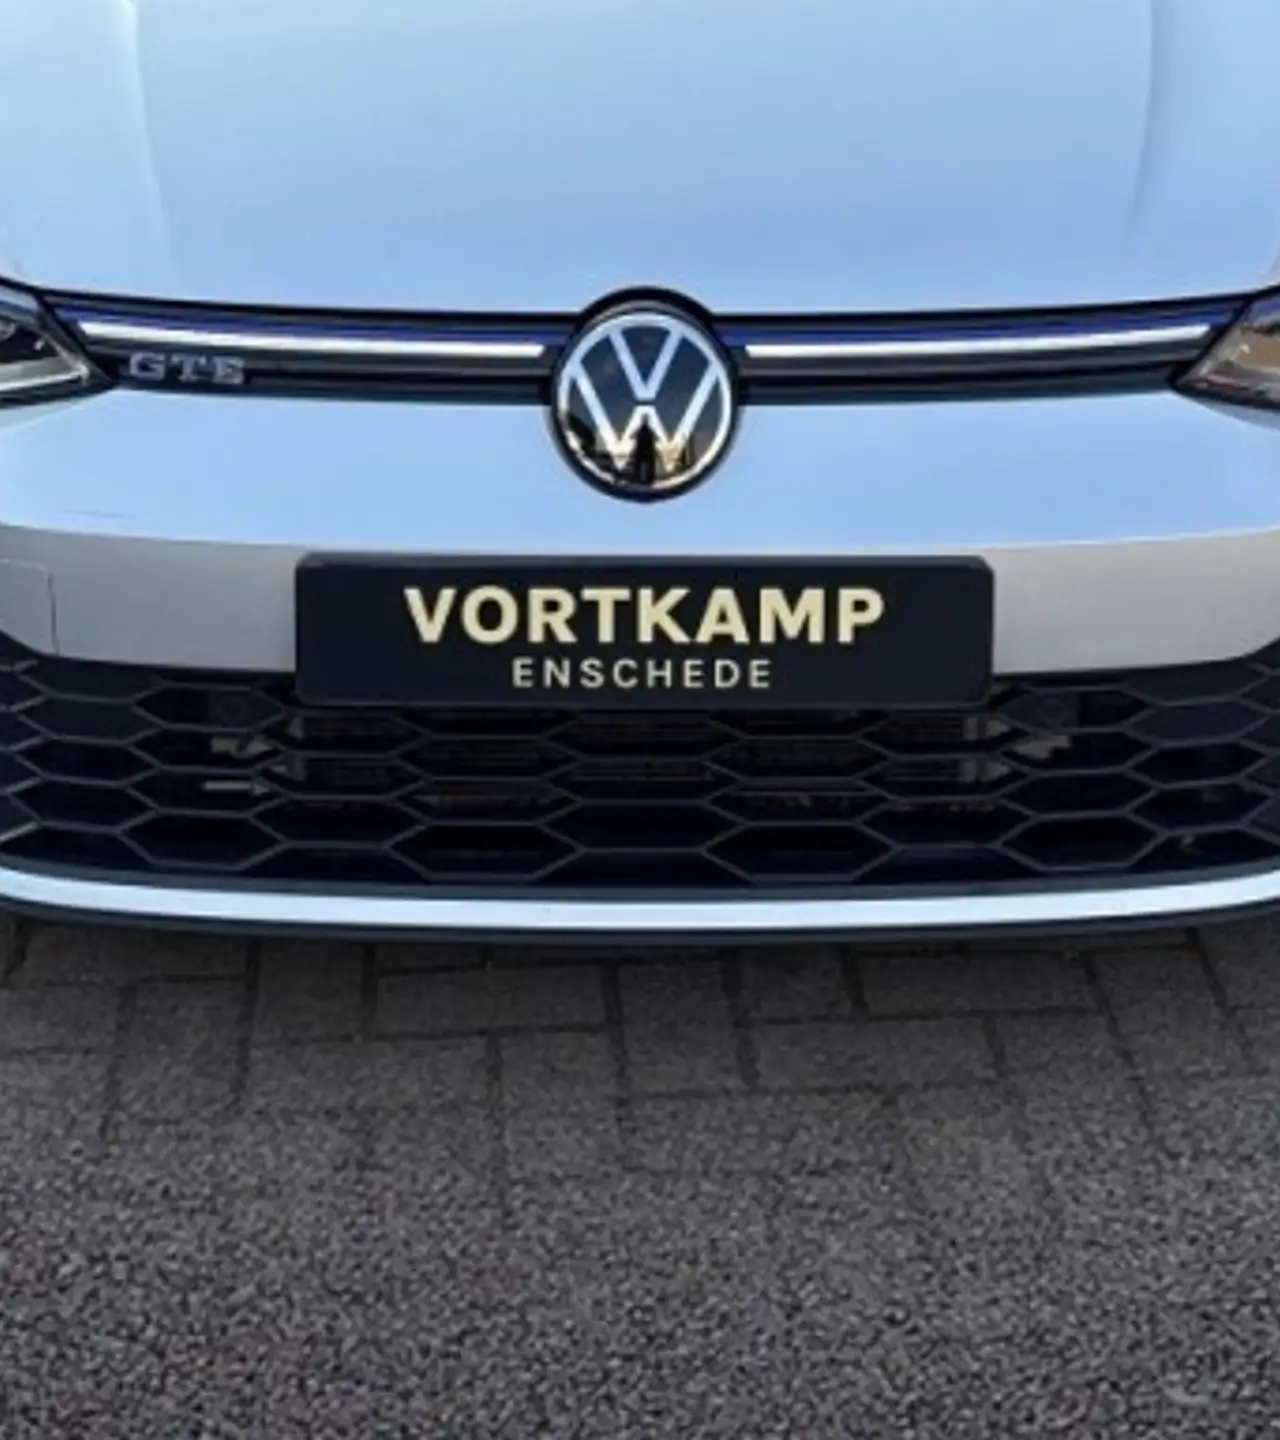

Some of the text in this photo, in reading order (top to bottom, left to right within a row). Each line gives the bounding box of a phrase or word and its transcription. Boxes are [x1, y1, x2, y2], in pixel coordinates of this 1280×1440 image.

[130, 352, 245, 385] GTE
[404, 585, 885, 644] VORTKAMP
[512, 657, 771, 689] ENSCHEDE
